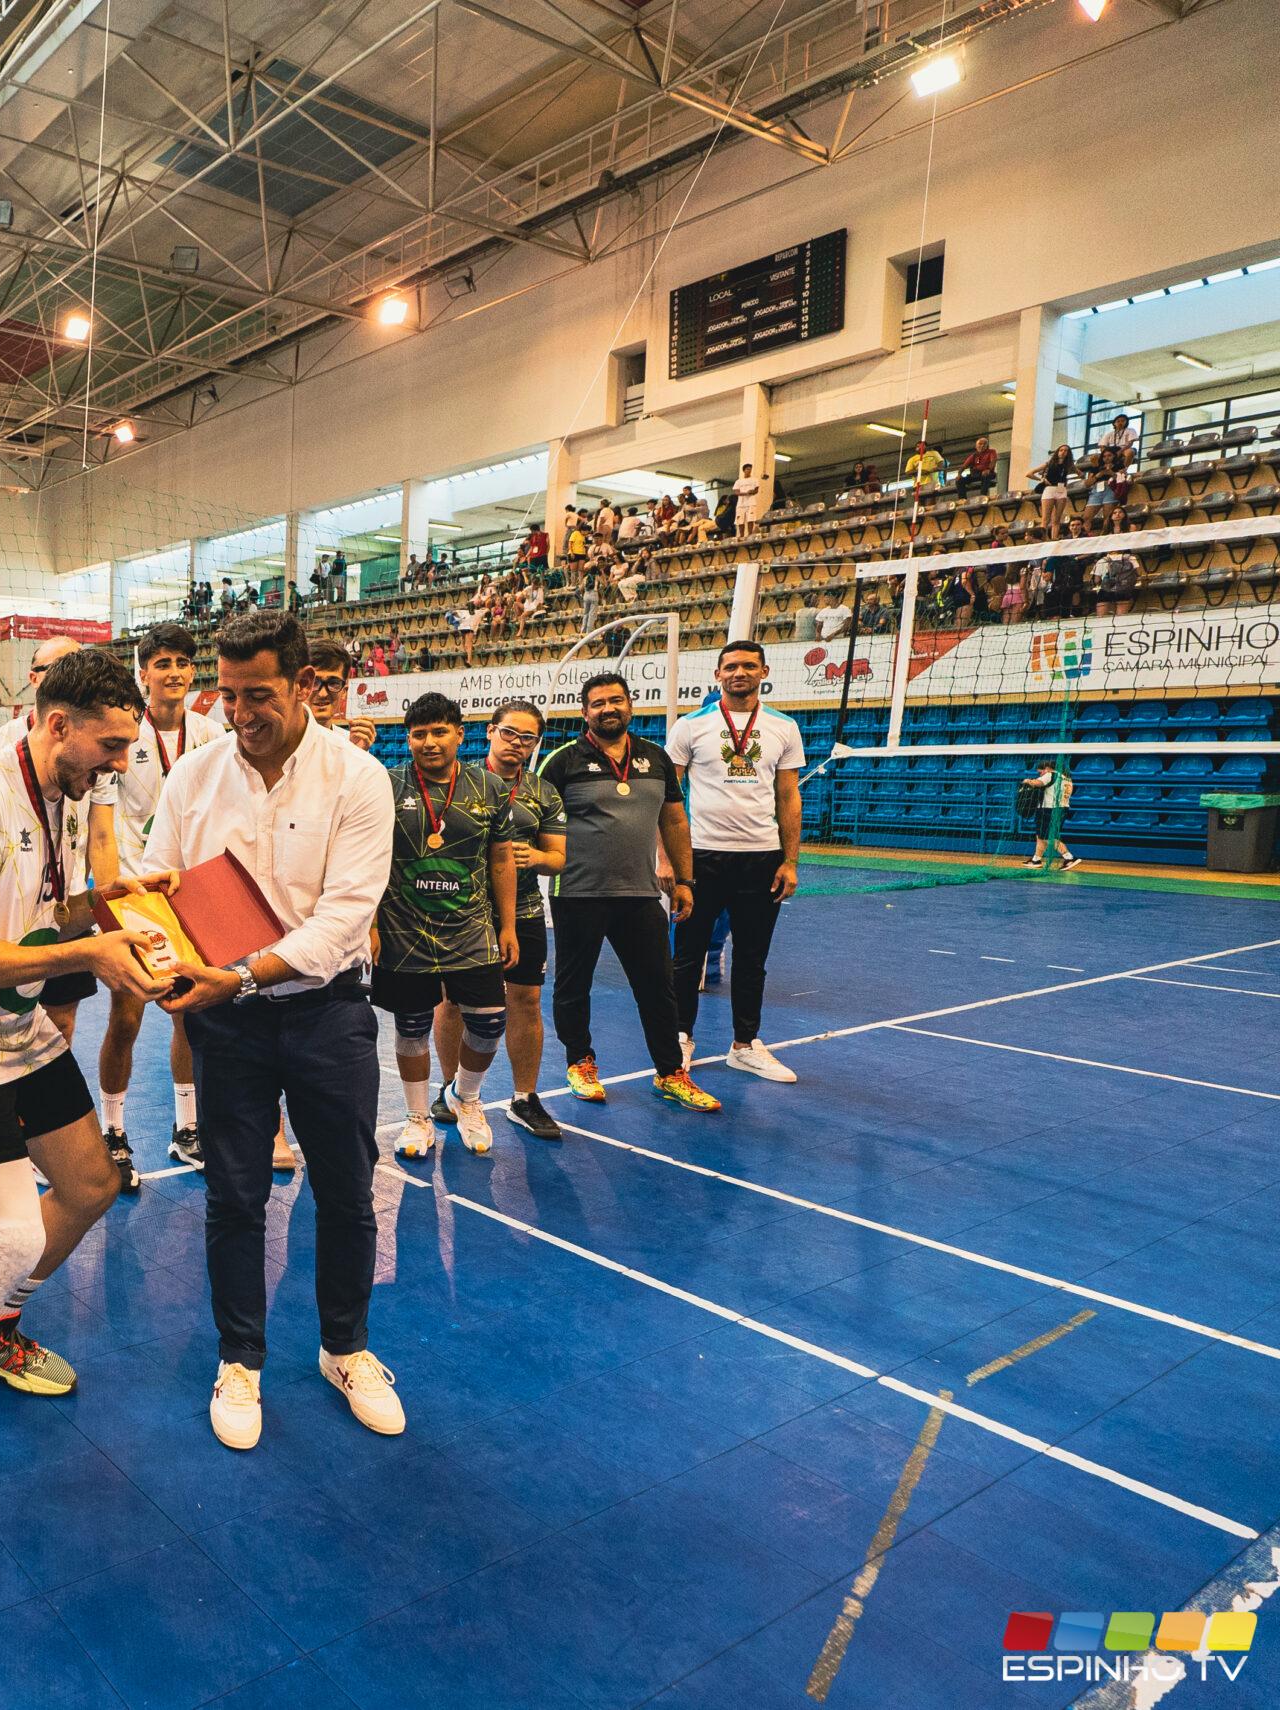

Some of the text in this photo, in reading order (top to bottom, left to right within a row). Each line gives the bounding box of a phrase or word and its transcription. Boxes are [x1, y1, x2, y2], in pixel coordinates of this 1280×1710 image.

[769, 266, 796, 281] VISITANTE
[708, 289, 734, 303] LOCAL
[1104, 622, 1279, 657] ESPINHO
[1103, 654, 1270, 673] CÂMARA MUNICIPAL
[461, 674, 492, 690] AMB
[498, 670, 541, 688] Youth
[642, 662, 666, 681] Cu
[416, 879, 461, 891] INTERIA
